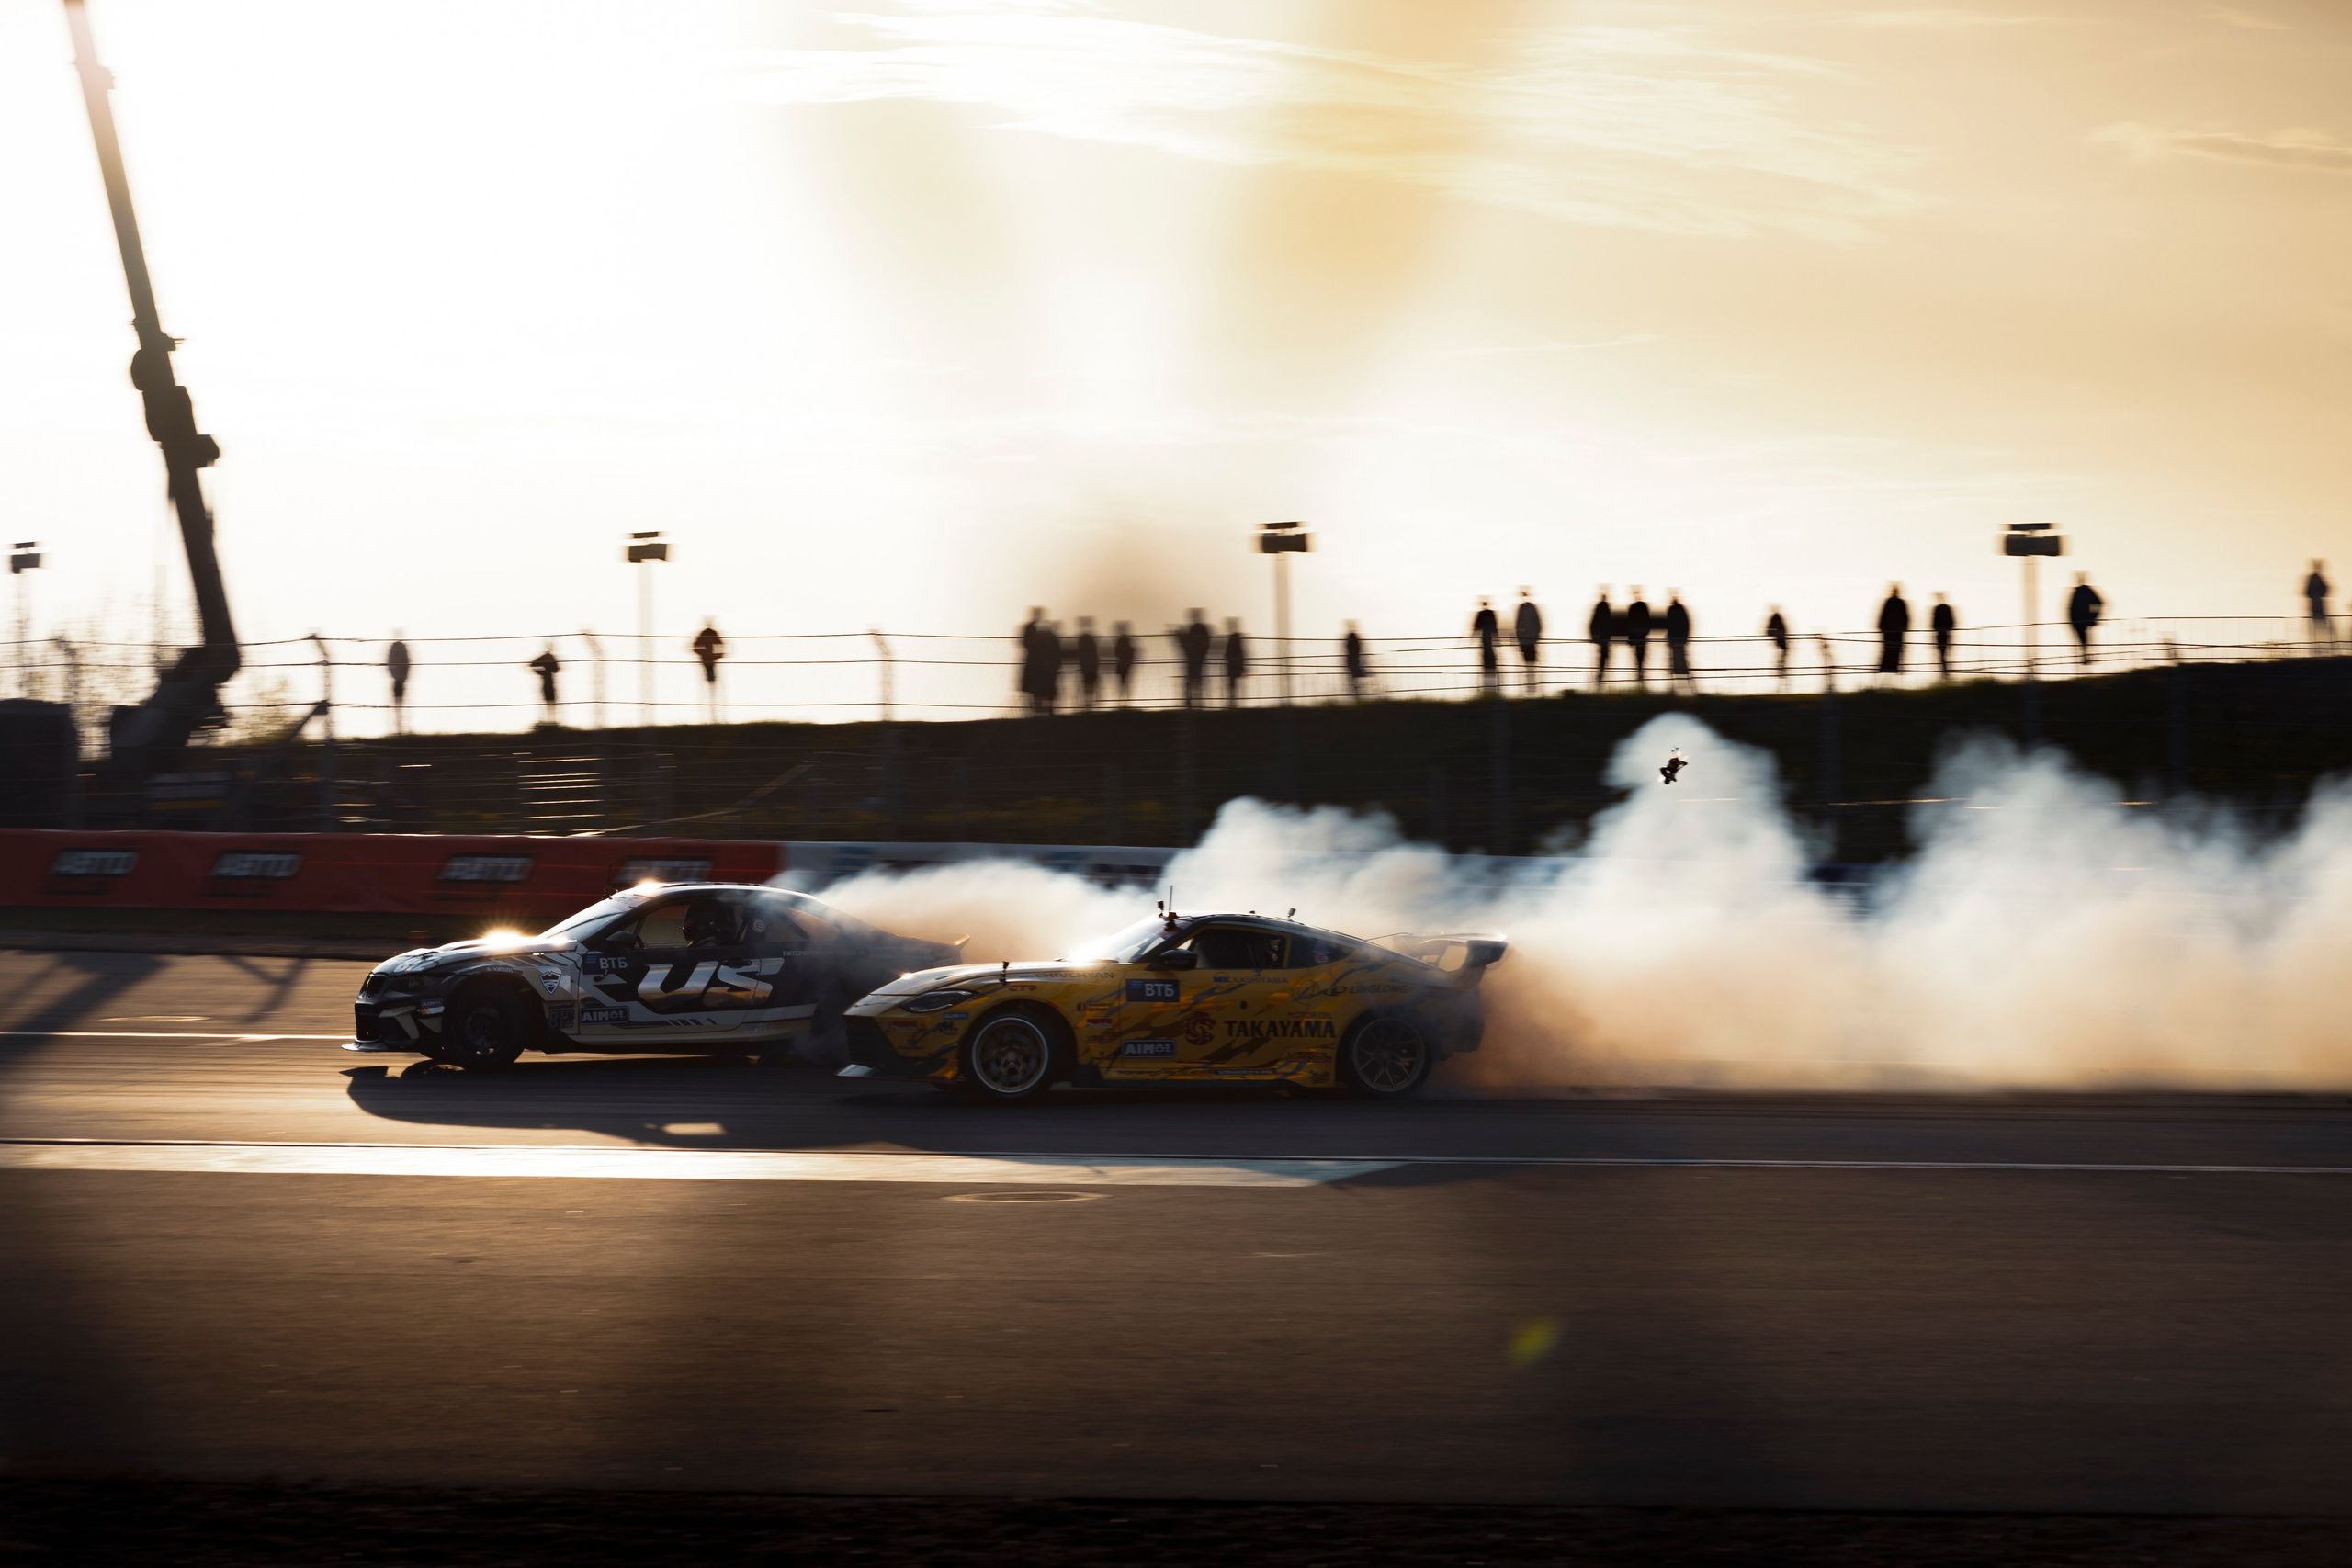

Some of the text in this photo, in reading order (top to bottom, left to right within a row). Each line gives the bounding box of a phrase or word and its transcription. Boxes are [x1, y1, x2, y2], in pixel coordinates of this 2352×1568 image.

[599, 957, 628, 970] ВТБ
[1035, 971, 1114, 979] CHIVCHYAN
[1145, 983, 1175, 997] ВТБ
[1350, 985, 1407, 994] LINGLONG
[582, 1010, 627, 1021] AIMOL
[1224, 1020, 1336, 1038] TAKAYAMA
[1125, 1043, 1173, 1055] AIMOL
